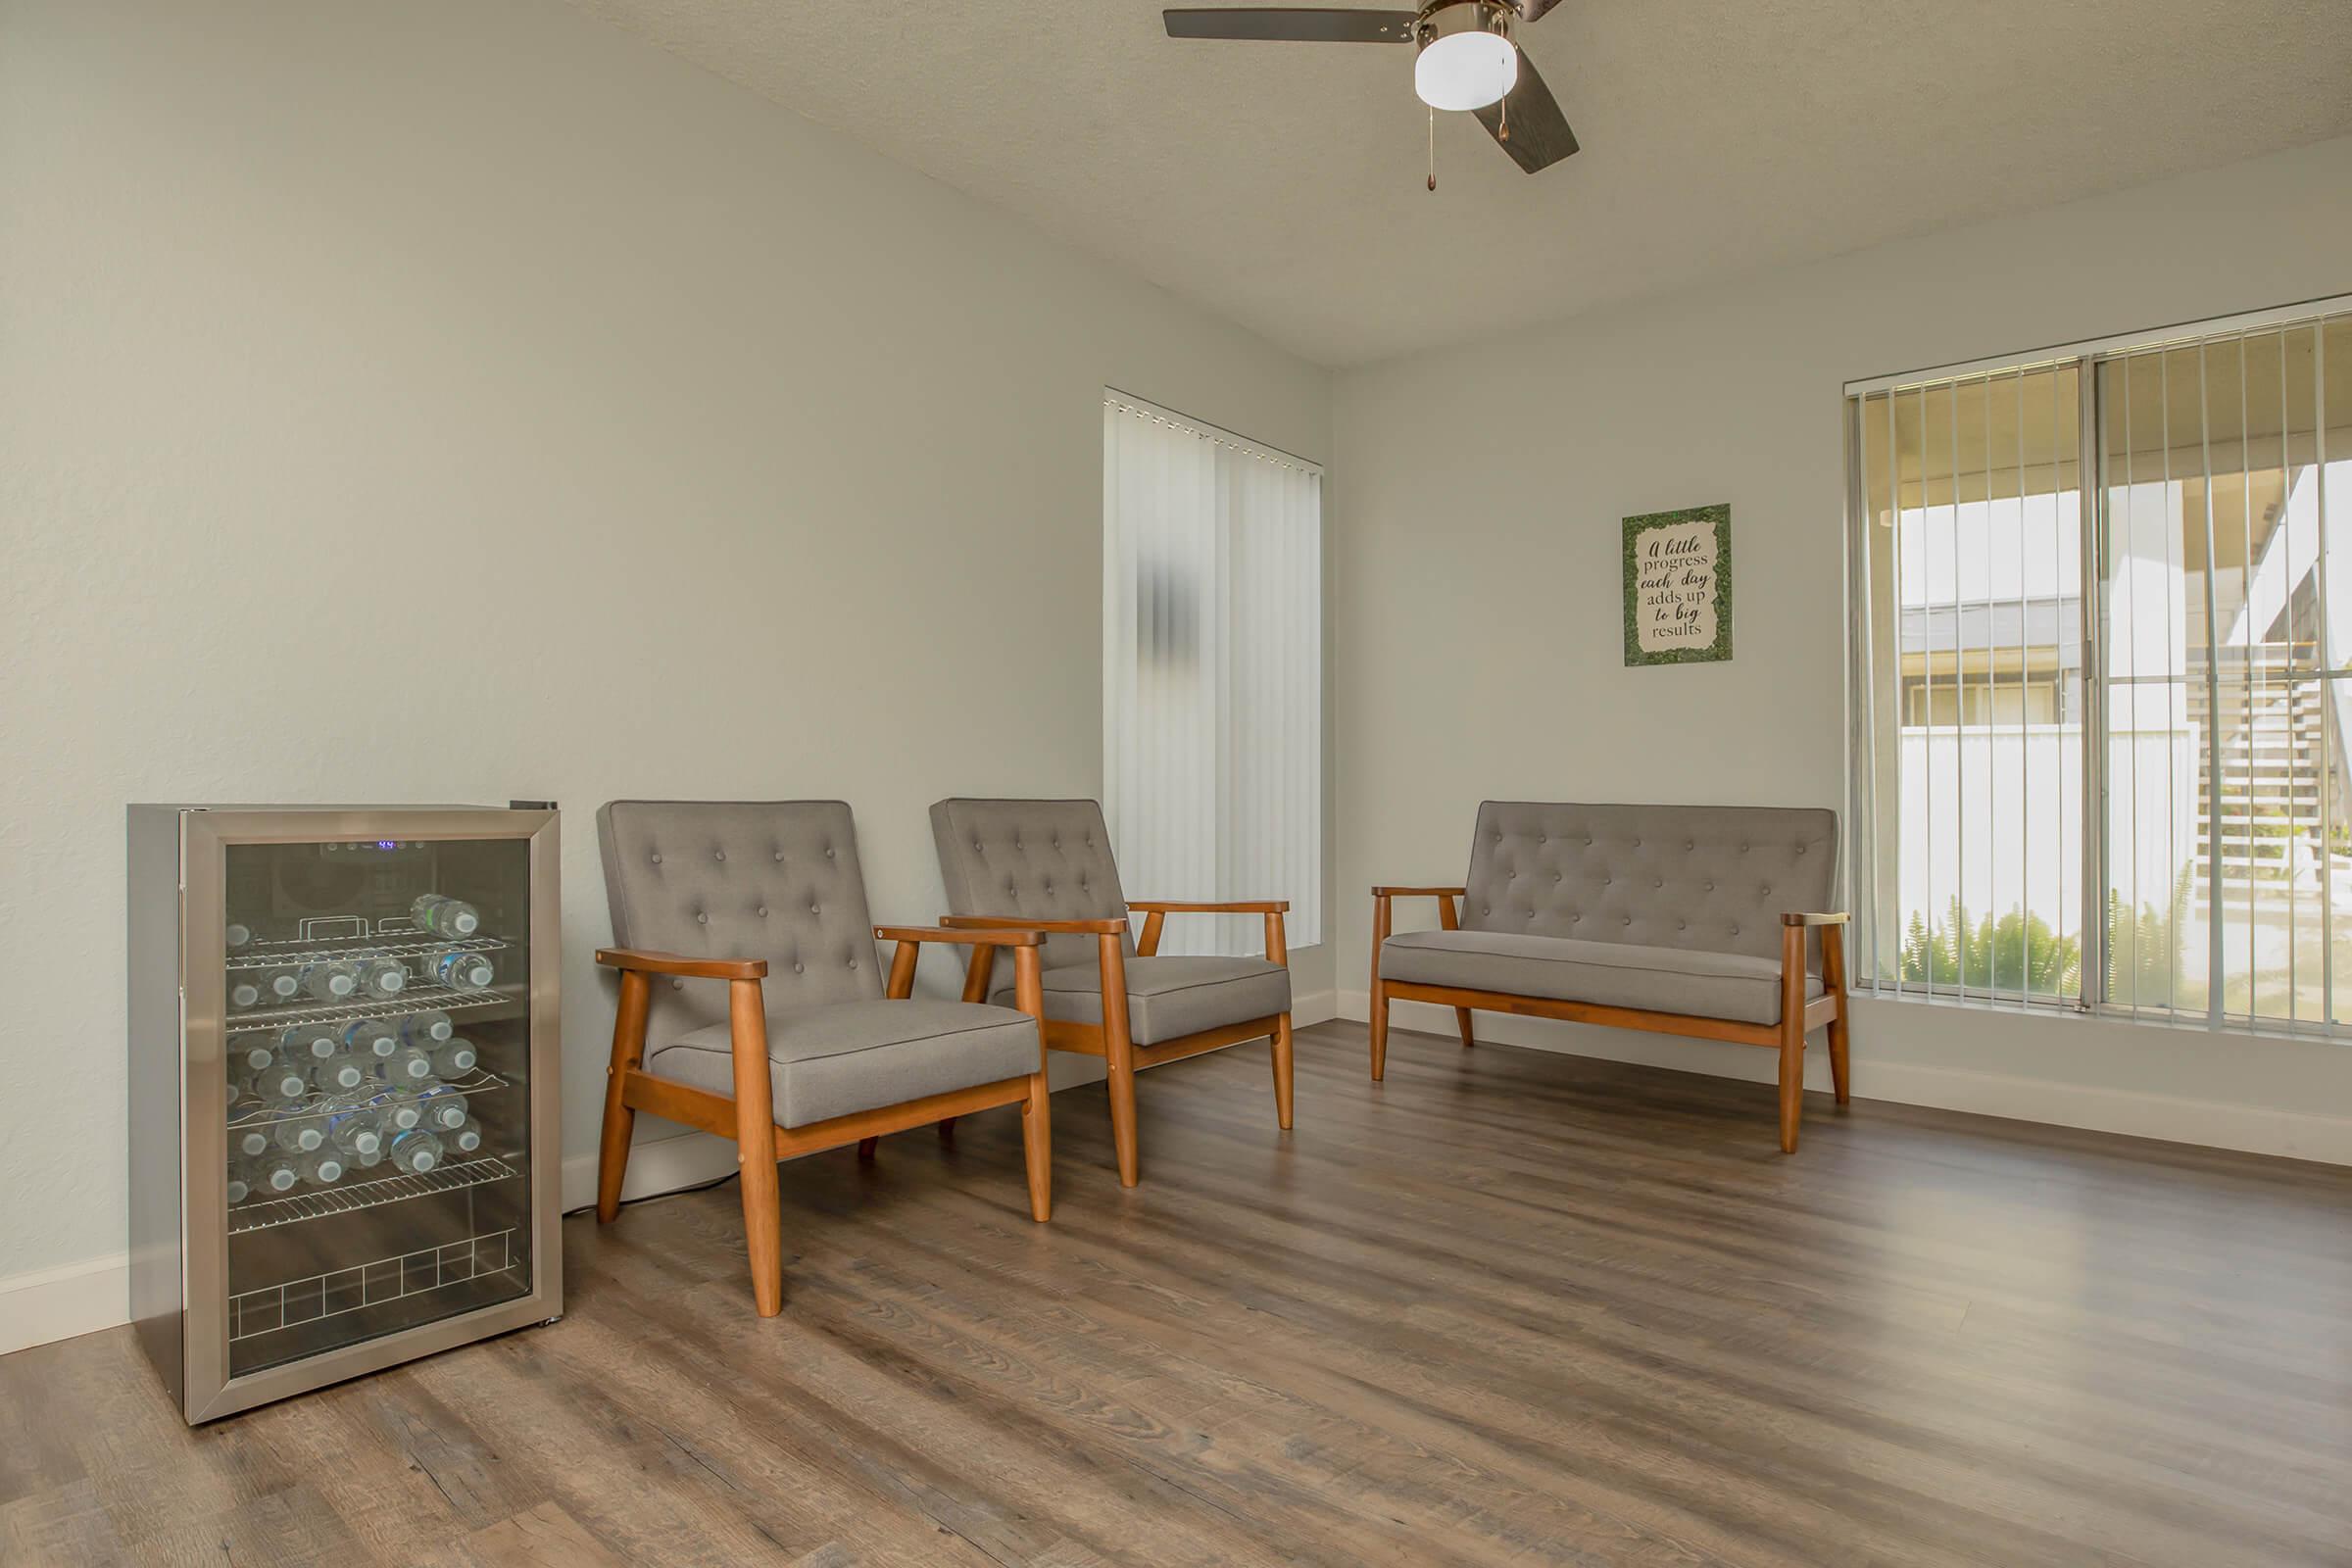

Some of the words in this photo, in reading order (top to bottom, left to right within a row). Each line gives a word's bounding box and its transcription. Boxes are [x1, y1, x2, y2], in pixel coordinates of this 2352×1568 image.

[1649, 541, 1660, 558] A
[1665, 536, 1701, 556] little
[1644, 556, 1708, 574] progress
[1641, 572, 1672, 589] each
[1681, 569, 1710, 590] day
[1647, 591, 1682, 605] adds
[1688, 591, 1705, 605] up
[1655, 608, 1669, 621] to
[1676, 603, 1701, 623] big
[1653, 622, 1701, 638] results
